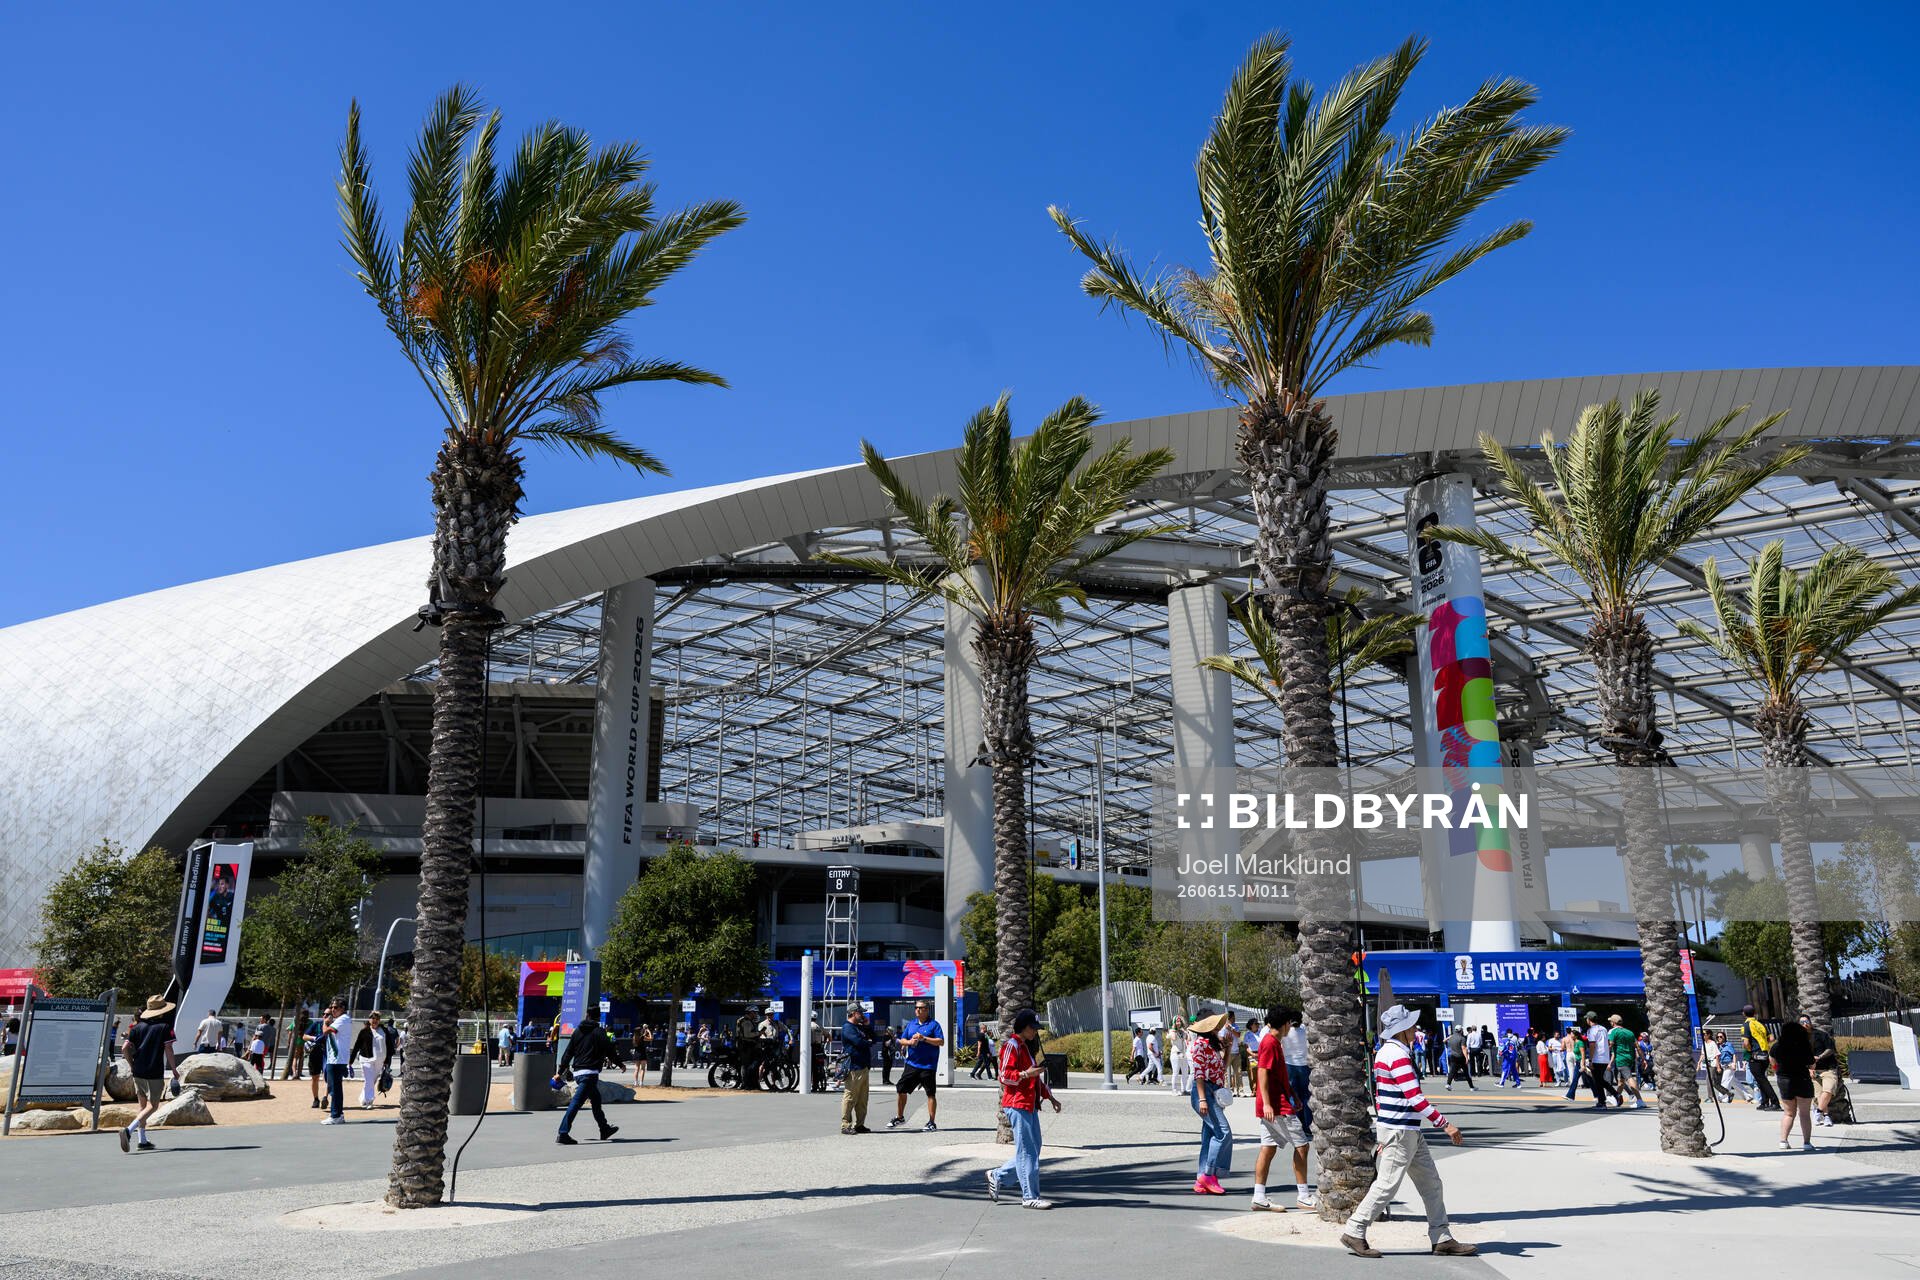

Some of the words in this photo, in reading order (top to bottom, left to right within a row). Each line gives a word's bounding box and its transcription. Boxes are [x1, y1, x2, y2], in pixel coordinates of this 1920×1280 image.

[1425, 559, 1437, 569] FIFA
[1421, 576, 1445, 594] 2026
[633, 616, 644, 684] 2026
[631, 686, 641, 724] CUP
[626, 727, 638, 800] WORLD
[1510, 748, 1522, 790] 2026
[623, 801, 633, 845] FIFA
[190, 854, 201, 889] Stadium
[829, 870, 850, 878] ENTRY
[836, 879, 843, 890] 8
[1522, 863, 1533, 889] FIFA
[181, 925, 190, 945] ENTRY
[1480, 962, 1541, 981] ENTRY
[1545, 962, 1559, 981] 8
